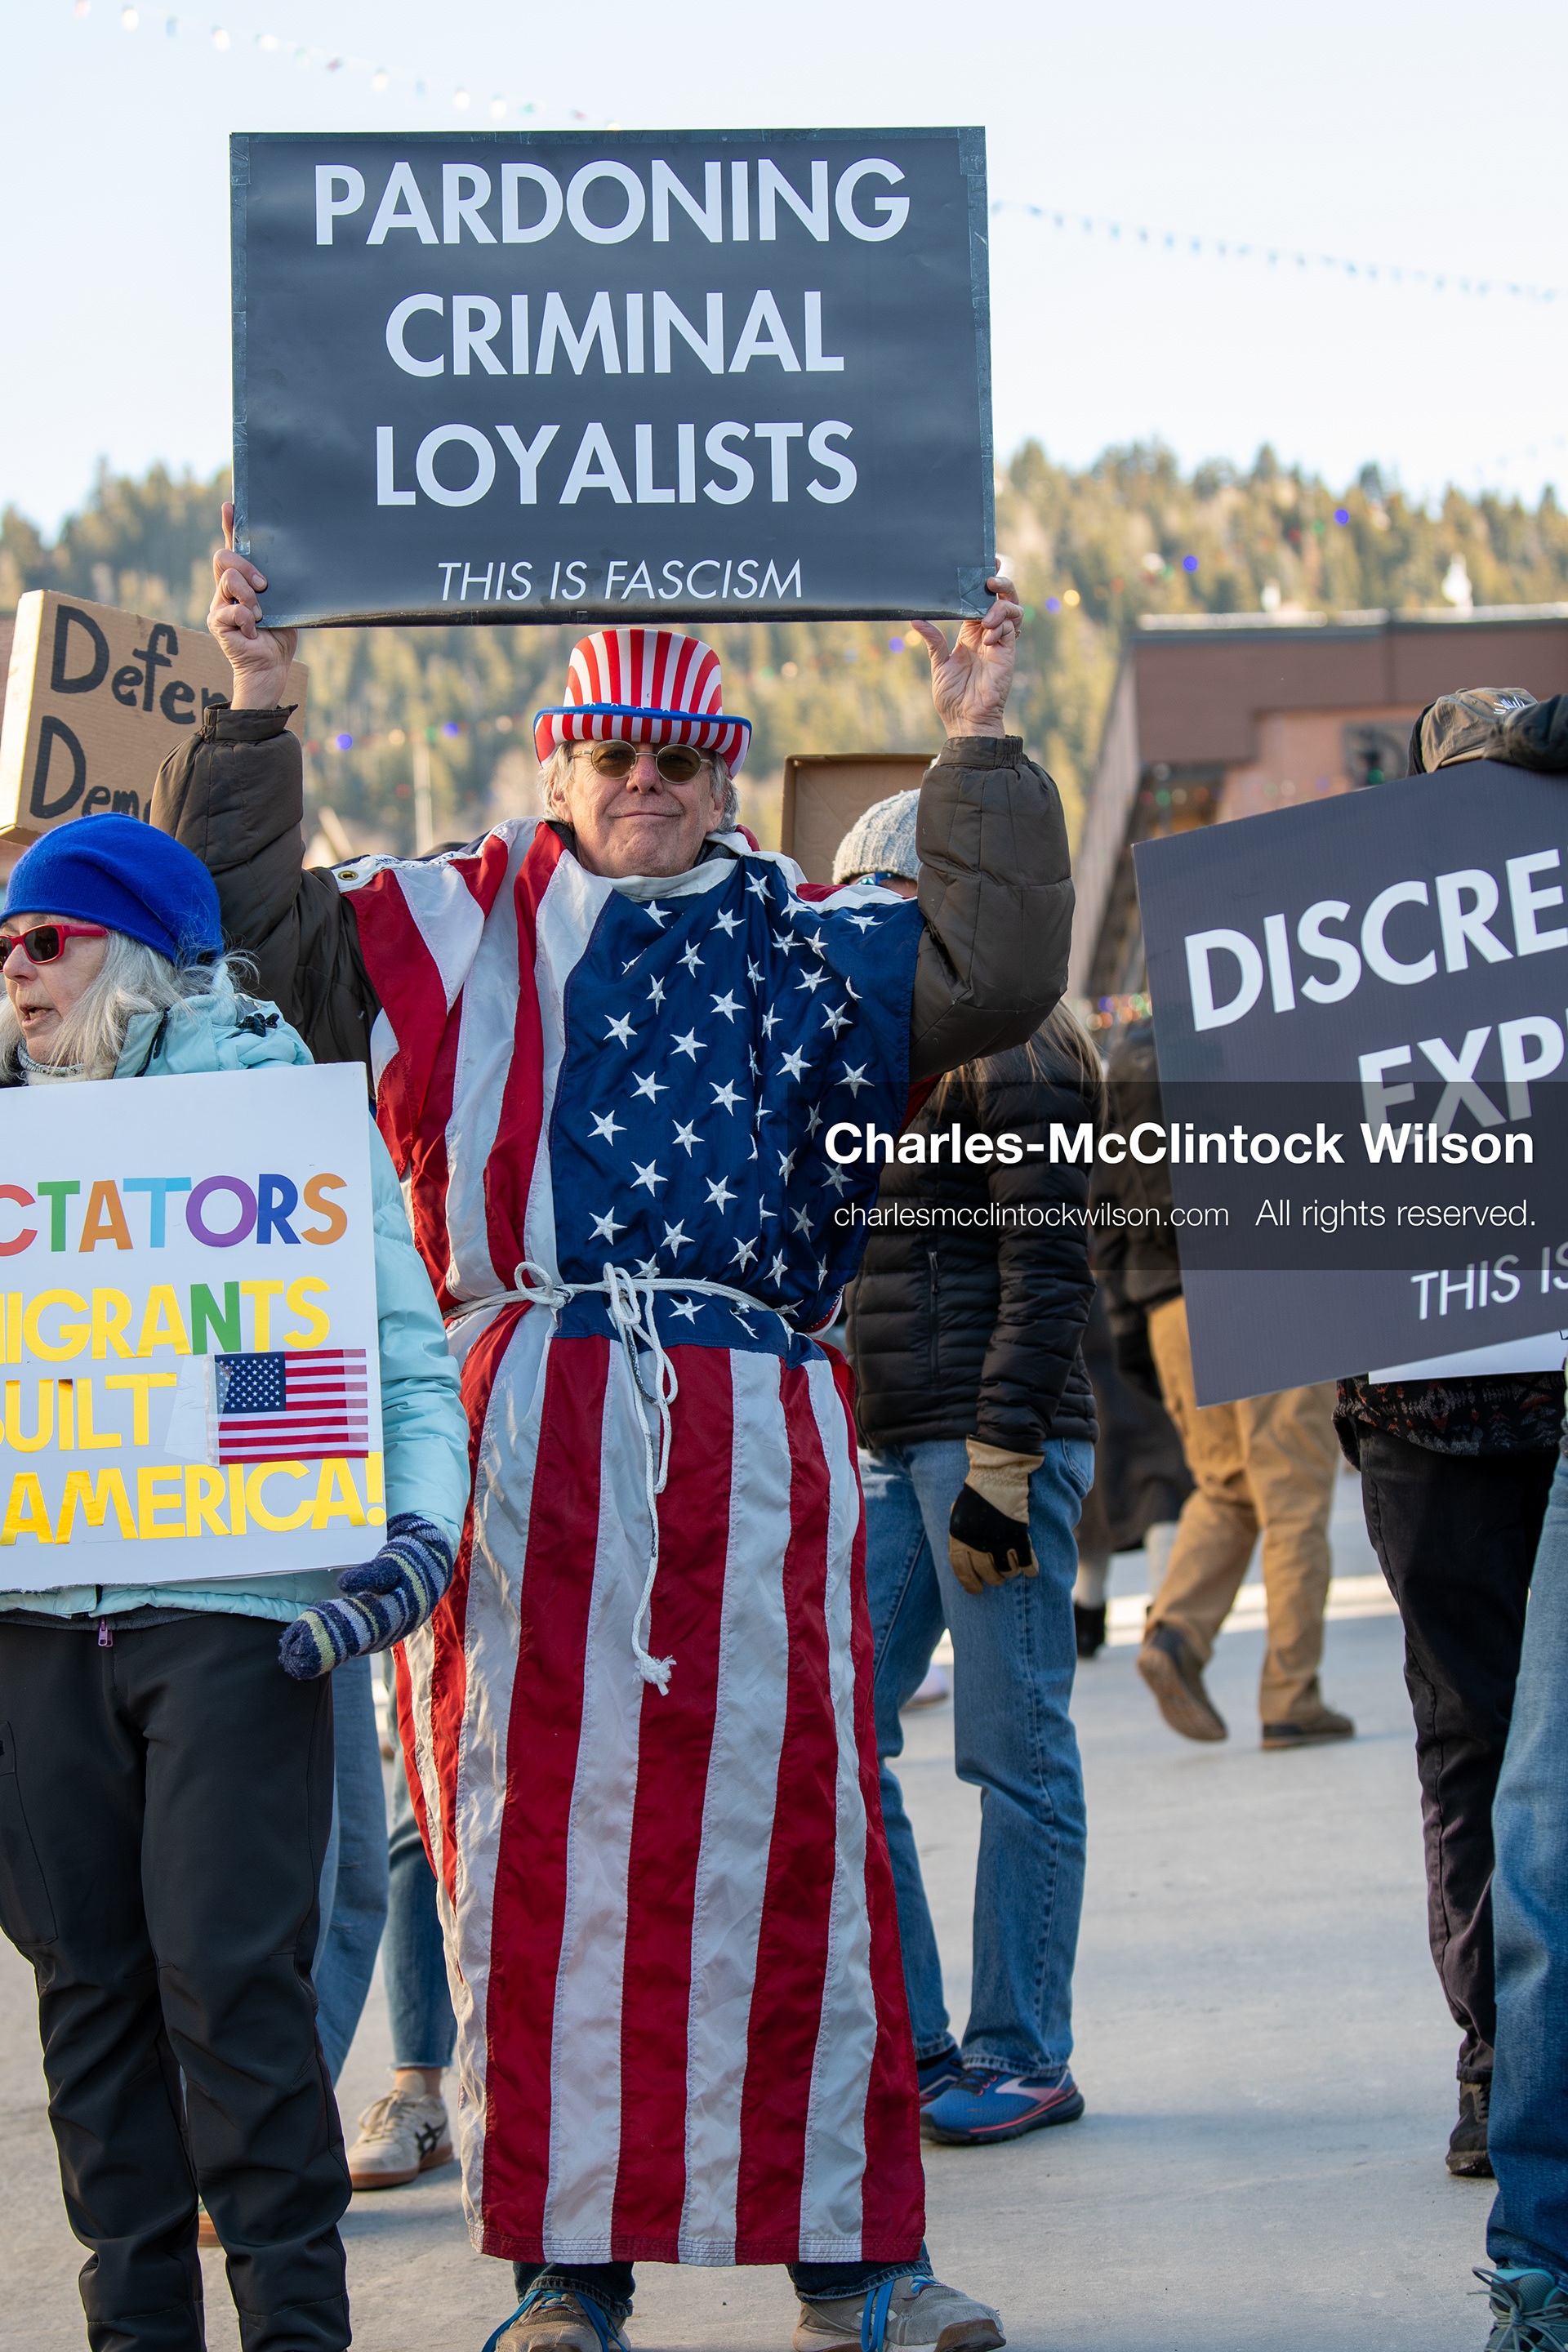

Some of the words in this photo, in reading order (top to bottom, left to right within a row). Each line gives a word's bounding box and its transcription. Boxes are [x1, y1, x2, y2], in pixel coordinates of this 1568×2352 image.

[315, 158, 910, 245] PARDONING
[385, 289, 844, 377] CRIMINAL
[376, 420, 858, 507] LOYALISTS
[438, 561, 532, 601] THIS
[550, 560, 587, 600] IS
[604, 559, 803, 599] FASCISM
[0, 1276, 331, 1365] IGRANTS
[1410, 1254, 1521, 1321] THIS
[0, 1372, 177, 1453] UILT
[0, 1452, 387, 1545] AMERICA!
